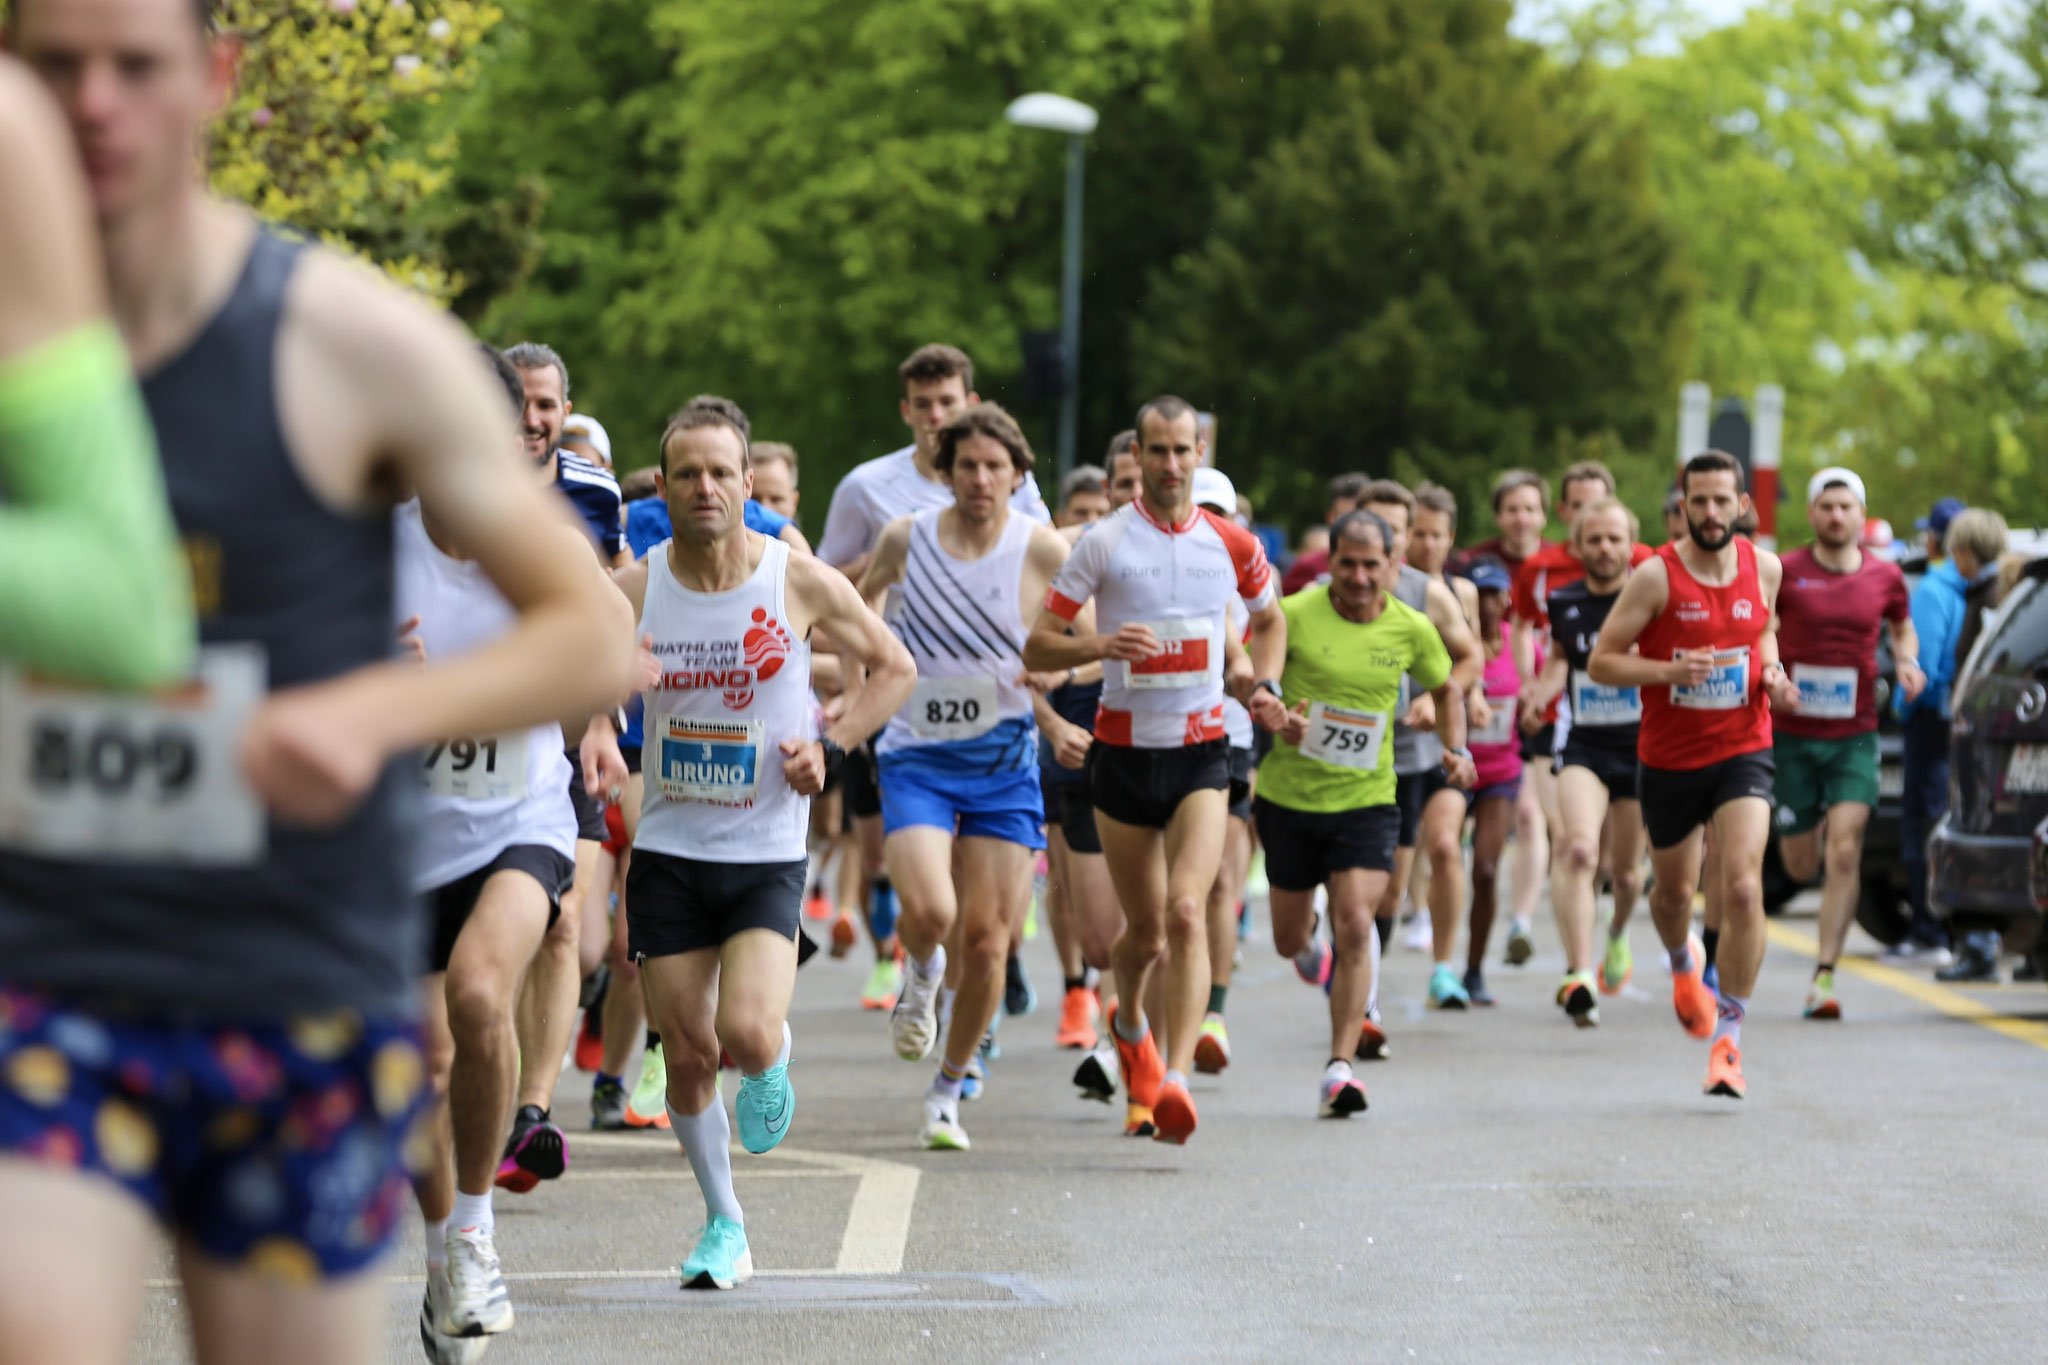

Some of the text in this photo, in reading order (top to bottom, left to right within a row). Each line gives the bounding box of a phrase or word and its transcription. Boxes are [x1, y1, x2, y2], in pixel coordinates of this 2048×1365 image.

[1120, 566, 1228, 580] pure sport
[652, 641, 738, 654] RIATHLON
[684, 656, 737, 667] TEAM
[654, 670, 752, 691] ICINO
[926, 699, 980, 723] 820
[1321, 724, 1369, 753] 759
[32, 714, 201, 802] 809
[424, 734, 498, 773] 791
[701, 741, 713, 761] 3
[670, 760, 746, 786] BRUNO
